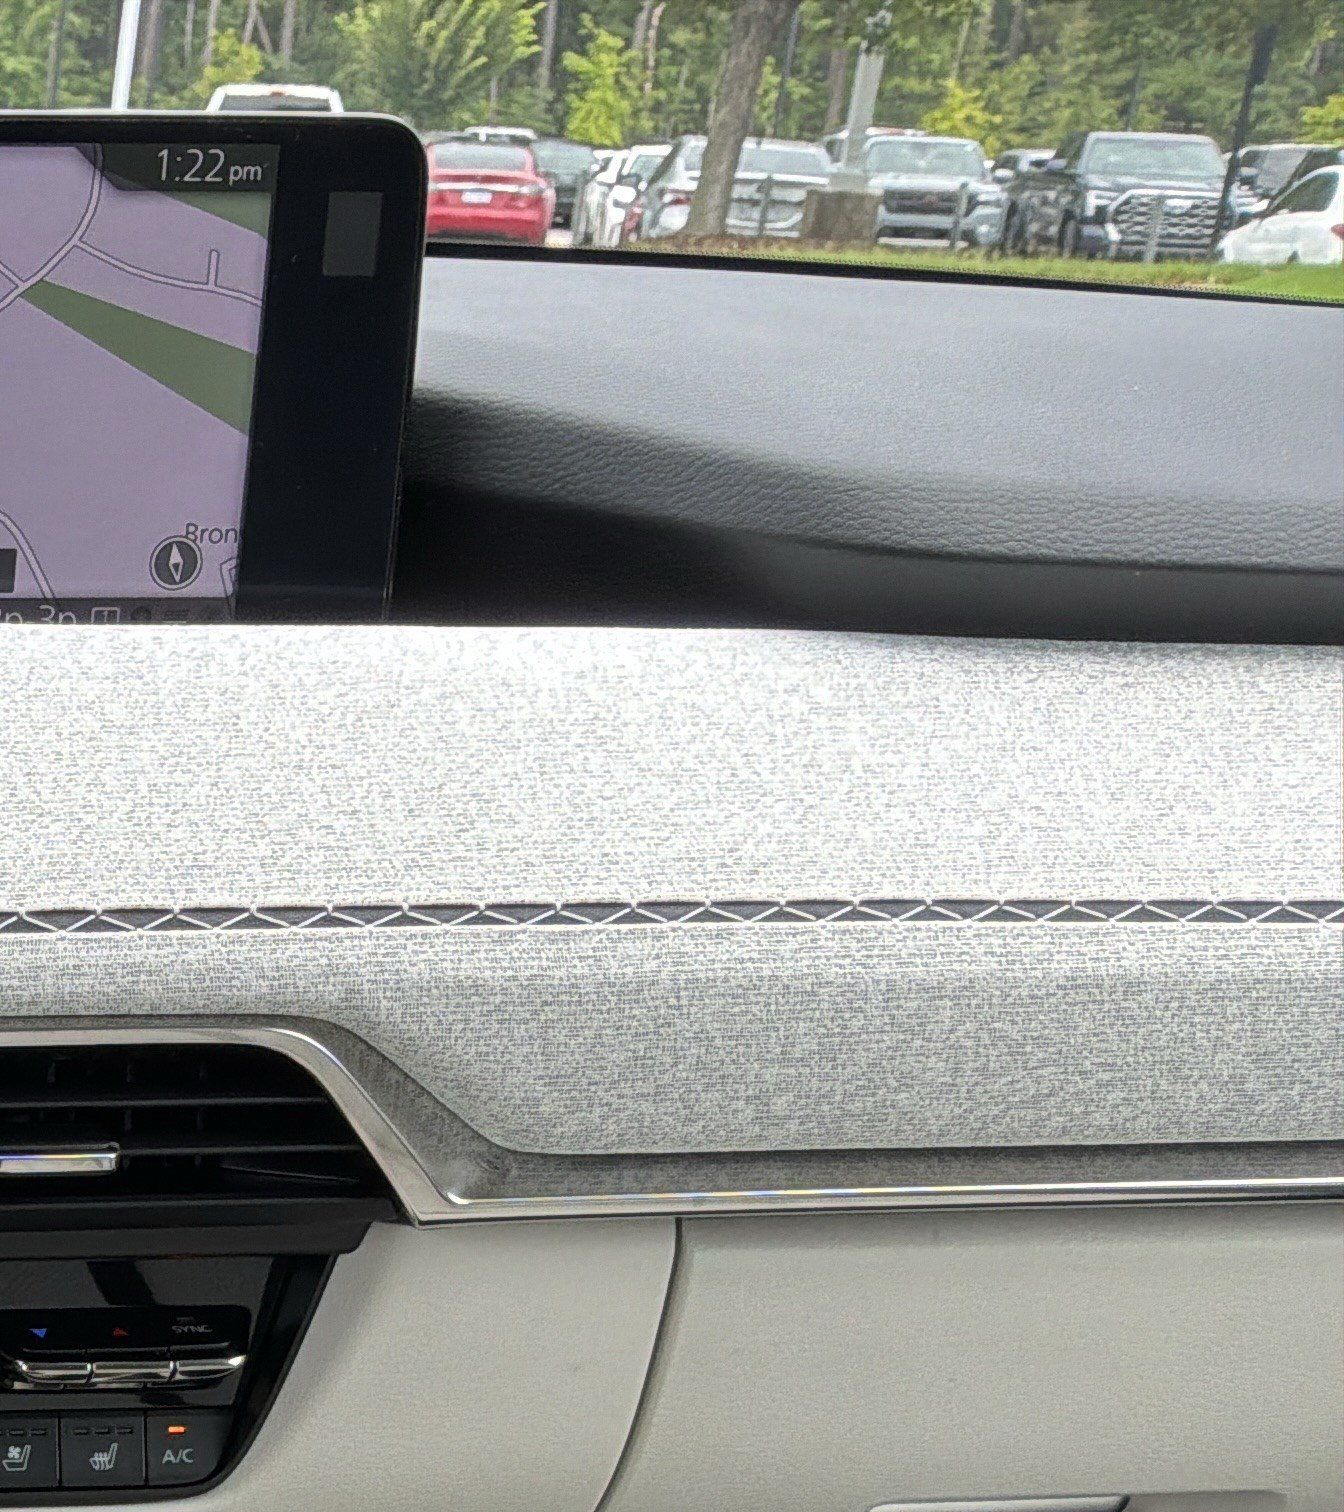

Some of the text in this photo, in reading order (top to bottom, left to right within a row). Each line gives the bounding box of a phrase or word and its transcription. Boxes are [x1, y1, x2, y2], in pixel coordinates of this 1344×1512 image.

[157, 148, 263, 187] 1:22 pm
[162, 1448, 194, 1464] A/C
